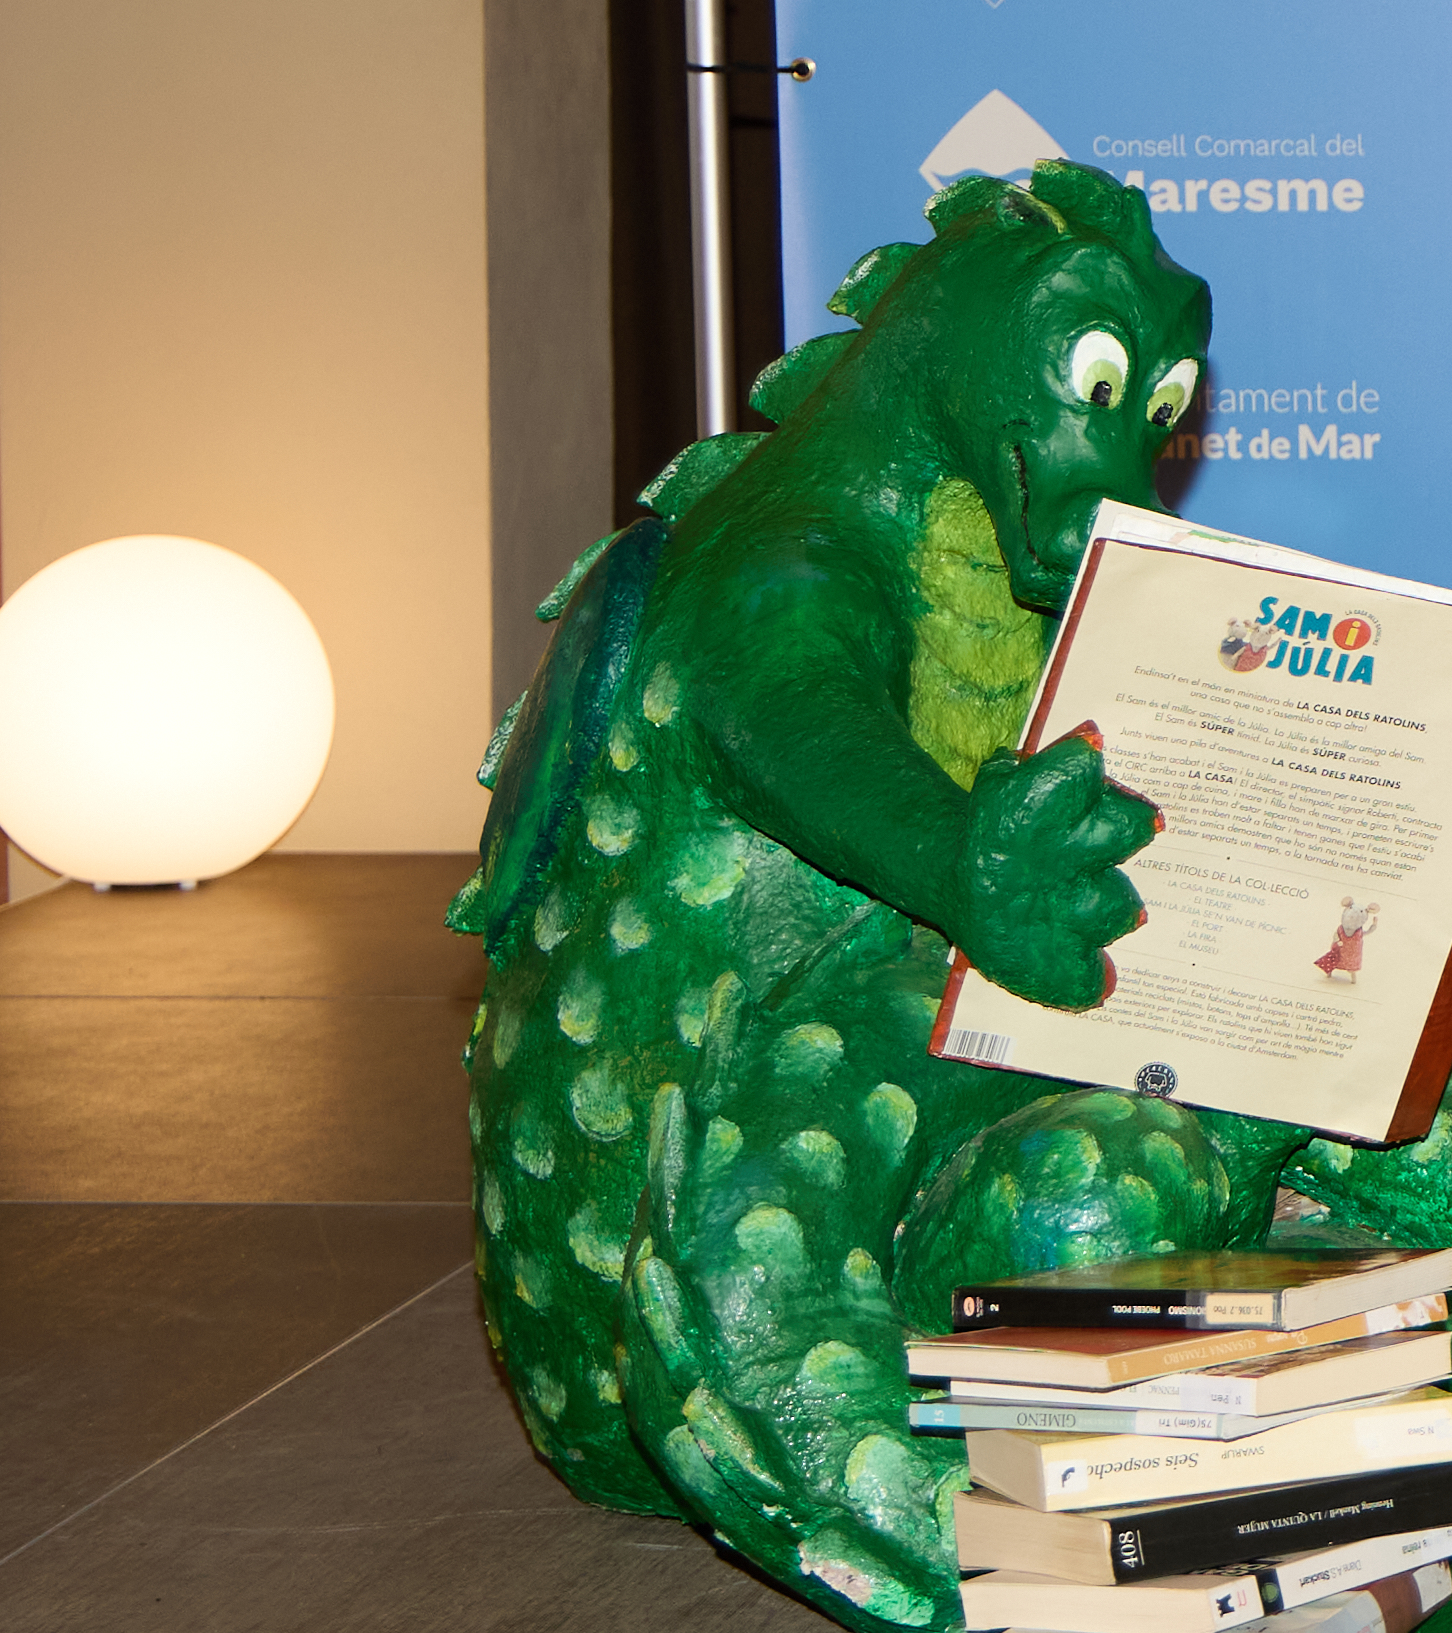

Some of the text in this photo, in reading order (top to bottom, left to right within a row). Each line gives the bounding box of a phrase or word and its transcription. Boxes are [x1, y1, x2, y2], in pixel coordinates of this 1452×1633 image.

[1256, 596, 1332, 641] SAM
[1345, 621, 1361, 646] i
[1266, 640, 1374, 685] JÚLIA
[1224, 686, 1235, 694] en
[1238, 689, 1280, 705] miniatura
[1282, 699, 1294, 707] de
[1296, 701, 1310, 711] LA
[1314, 704, 1342, 716] CASA
[1346, 709, 1370, 721] DELS
[1373, 714, 1428, 733] RATOLINS,
[1120, 727, 1142, 739] Junts
[1144, 732, 1168, 743] viuen
[1170, 737, 1188, 745] una
[1189, 739, 1206, 749] pila
[1210, 742, 1260, 761] d'aventures
[1272, 757, 1284, 767] LA
[1288, 761, 1317, 775] CASA
[1321, 769, 1346, 780] DELS
[1134, 859, 1171, 871] ALTRES
[1174, 863, 1208, 878] TÍTOLS
[1212, 871, 1226, 881] DE
[1229, 874, 1241, 885] LA
[1112, 1305, 1132, 1315] POOL
[1134, 1305, 1161, 1315] PHOEBE
[1163, 1345, 1207, 1365] TAMARO
[1209, 1337, 1257, 1357] SUSANNA
[1149, 1384, 1180, 1395] PENNAC
[1210, 1393, 1242, 1405] N Pen
[1016, 1412, 1076, 1427] GIMENO
[1158, 1417, 1212, 1429] 75(Gim) Tri
[1407, 1427, 1426, 1436] Swa
[1222, 1445, 1265, 1460] SWARUP
[1166, 1451, 1200, 1471] Seis
[1330, 1504, 1360, 1517] Mankell
[1362, 1497, 1394, 1512] Henning
[1271, 1511, 1308, 1529] QUINTA
[1308, 1511, 1322, 1523] LA
[1237, 1519, 1270, 1535] MUJER
[1120, 1531, 1137, 1567] 408
[1299, 1569, 1332, 1588] Stuckart
